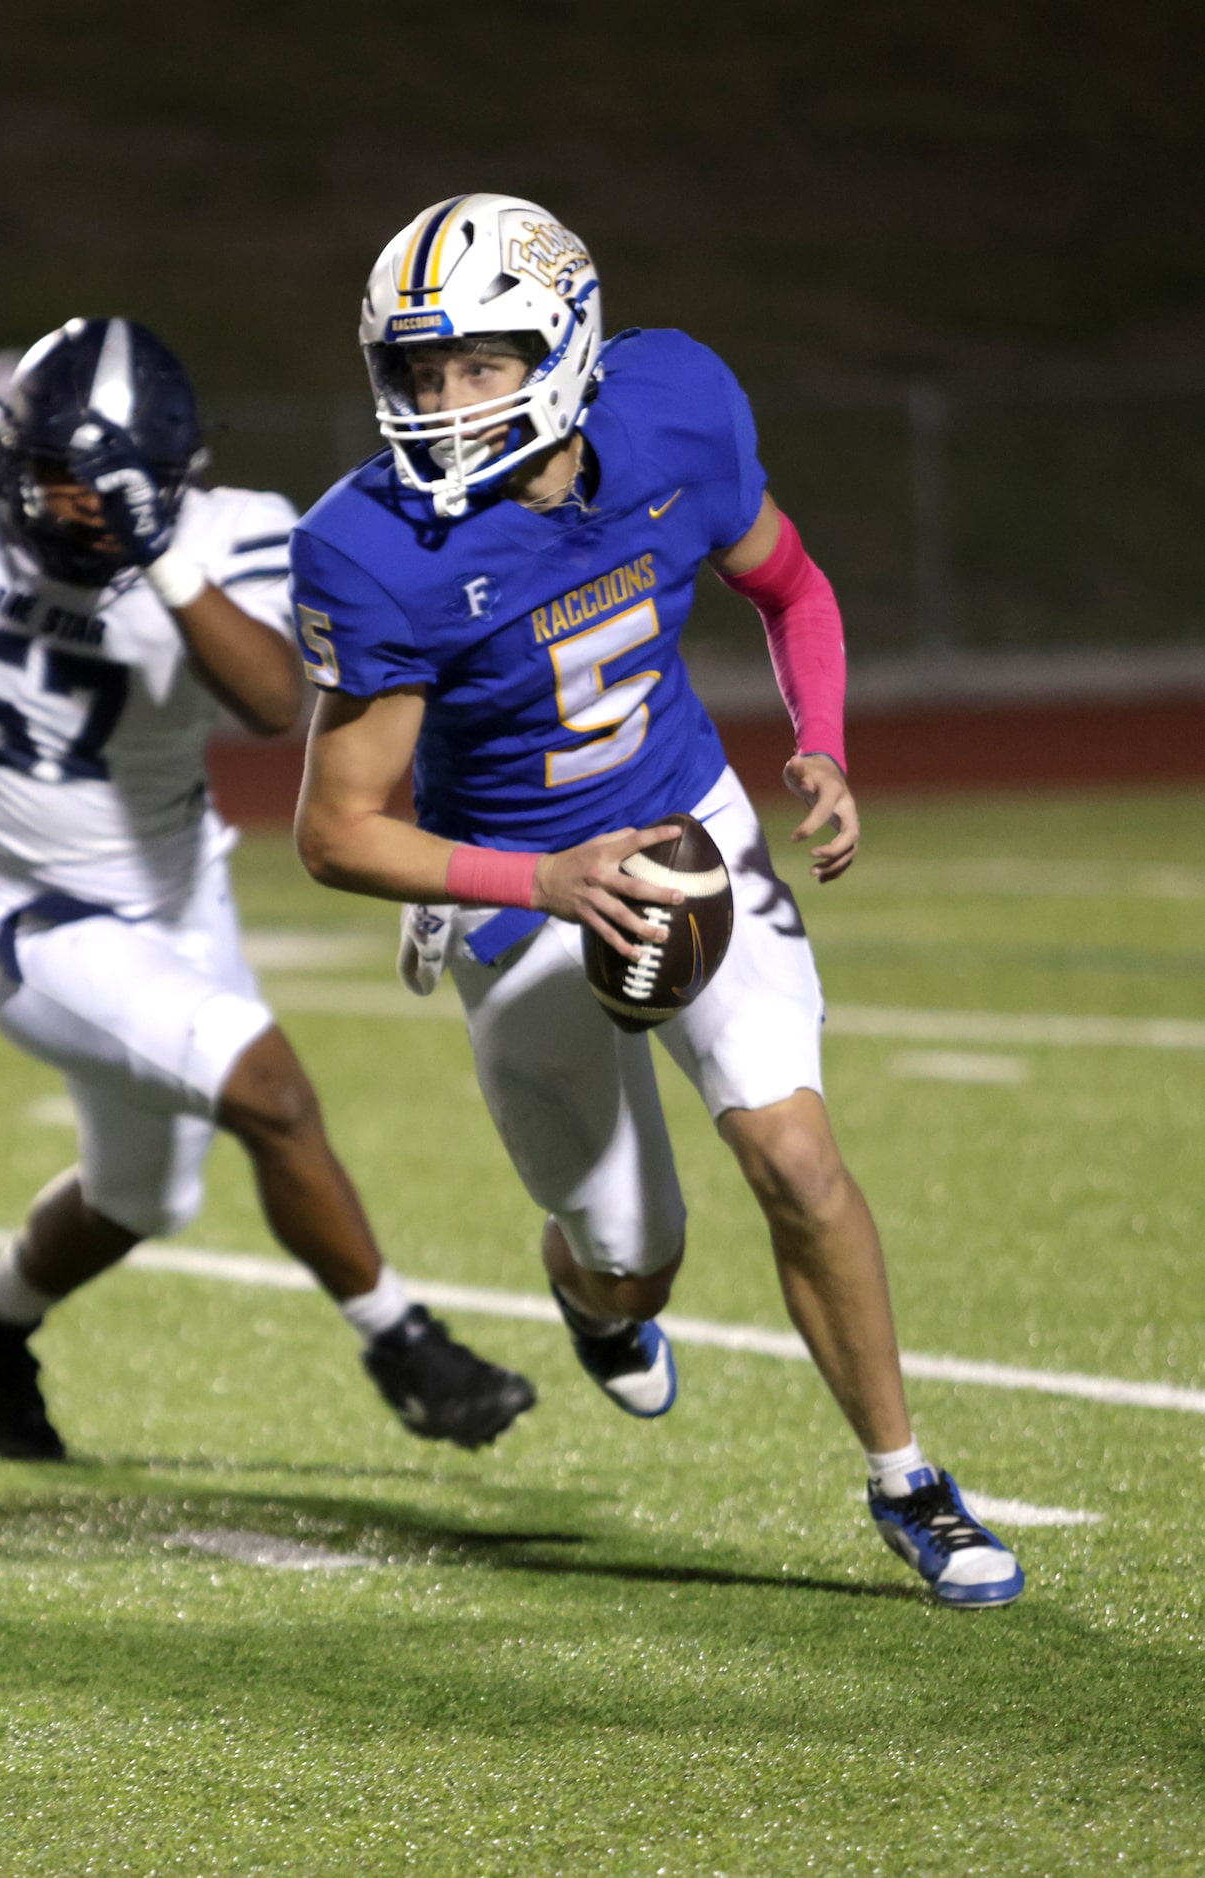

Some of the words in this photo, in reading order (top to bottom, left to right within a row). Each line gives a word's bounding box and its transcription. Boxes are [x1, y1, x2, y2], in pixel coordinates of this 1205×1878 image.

[462, 575, 490, 618] F
[533, 554, 657, 643] RACCOONS
[297, 603, 341, 687] 5
[544, 598, 661, 788] 5
